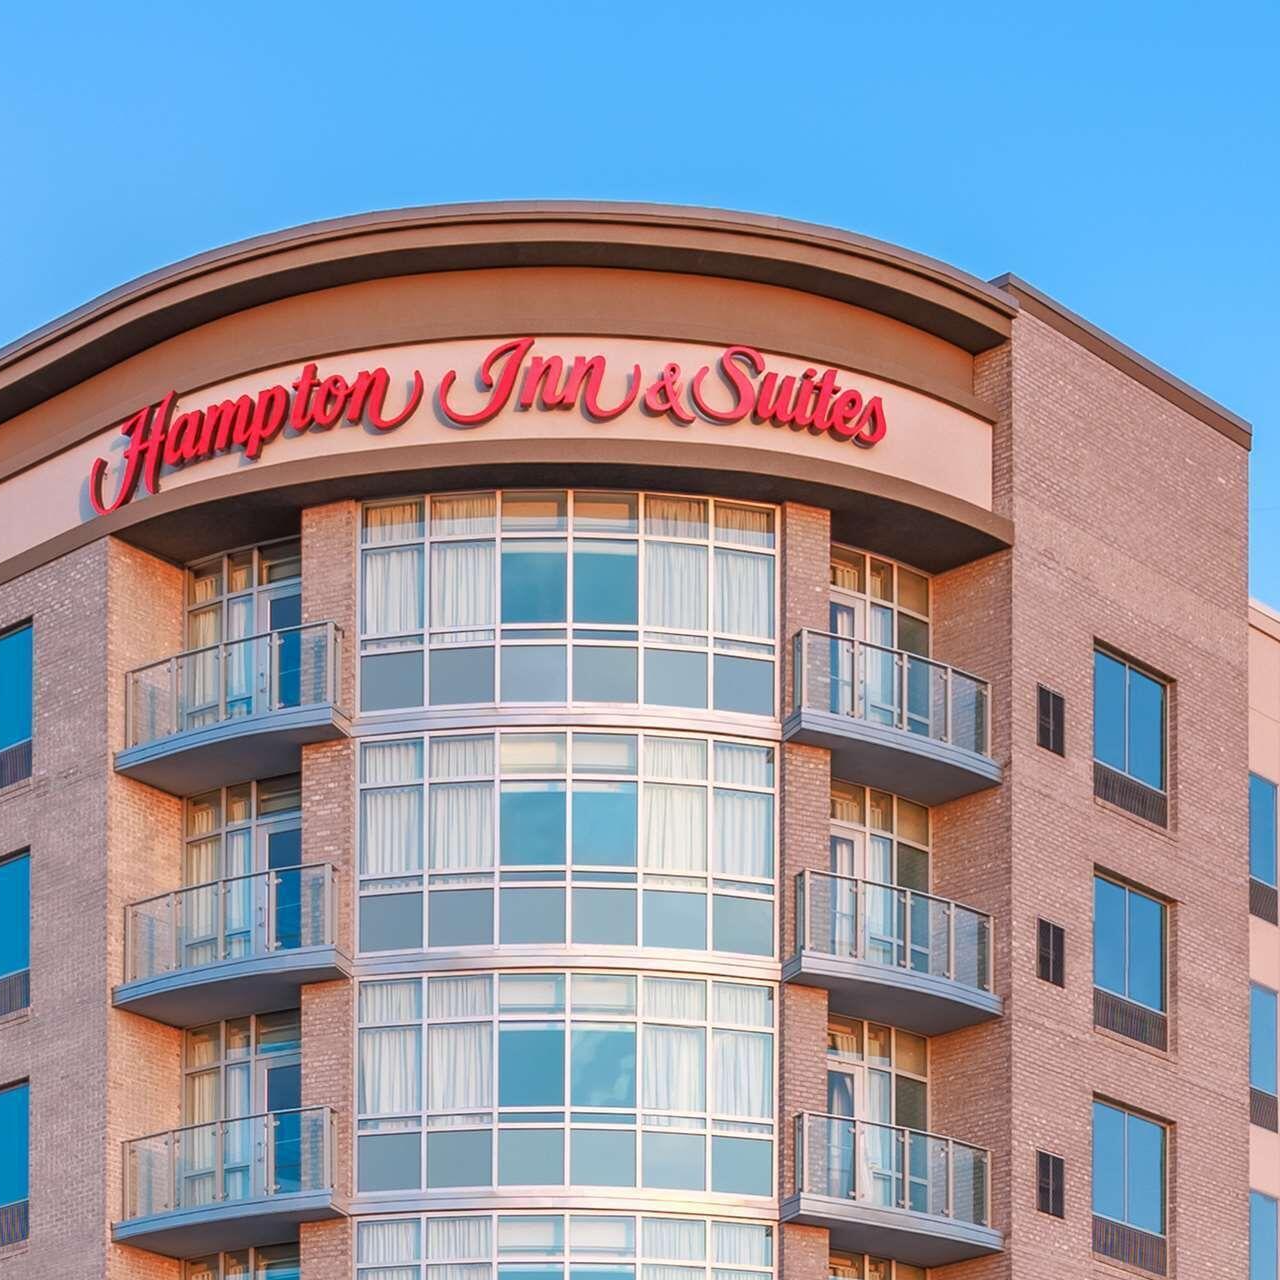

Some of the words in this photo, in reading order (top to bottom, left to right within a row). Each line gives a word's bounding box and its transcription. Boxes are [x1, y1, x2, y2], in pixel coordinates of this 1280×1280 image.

[90, 364, 424, 517] Hampton
[439, 337, 643, 425] Inn
[645, 362, 697, 425] &
[692, 344, 888, 447] Suites
